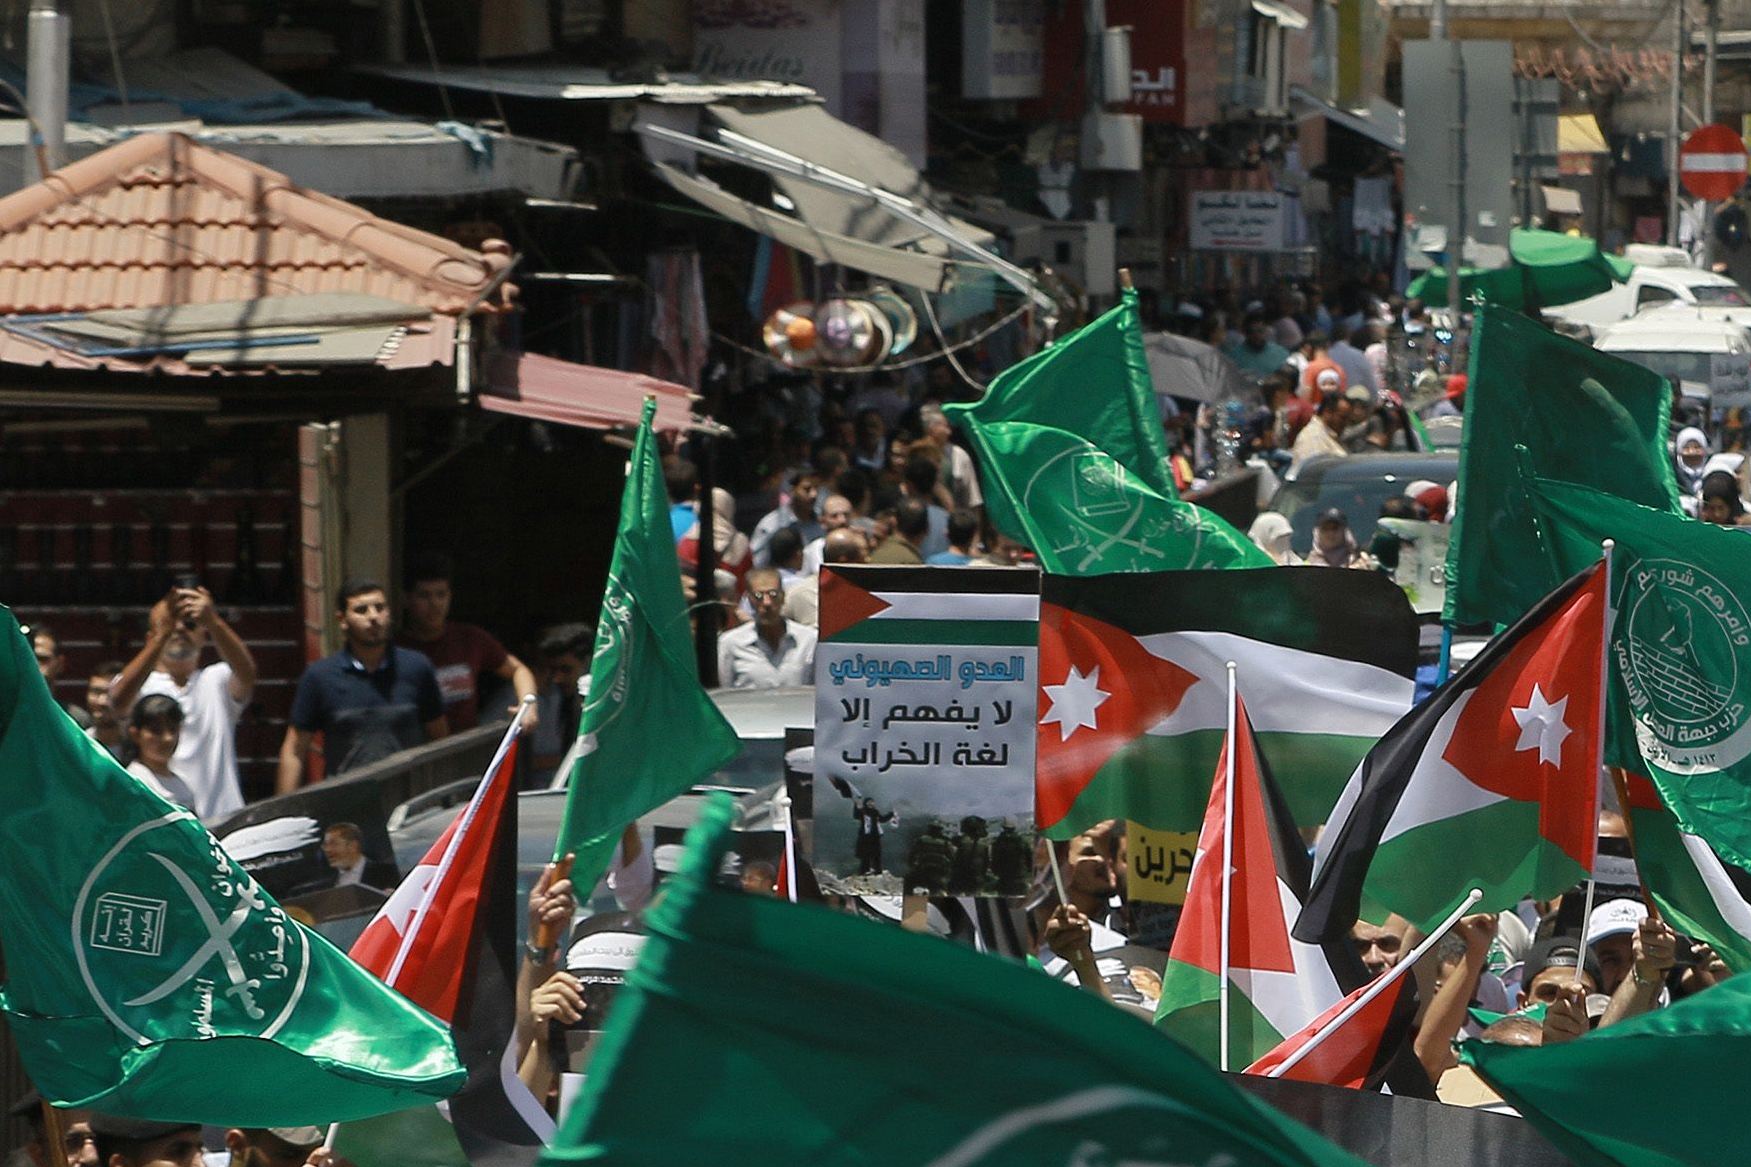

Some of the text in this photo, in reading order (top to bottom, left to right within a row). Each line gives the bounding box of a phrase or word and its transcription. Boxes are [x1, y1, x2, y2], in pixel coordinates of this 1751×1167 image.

[829, 653, 1025, 689] العدو الصهيوني
[840, 697, 1012, 730] لا يفهم إلا
[1719, 703, 1744, 731] حزب
[1678, 723, 1718, 742] جبهة
[842, 740, 1008, 772] لغة الخراب
[1135, 836, 1194, 885] حرين
